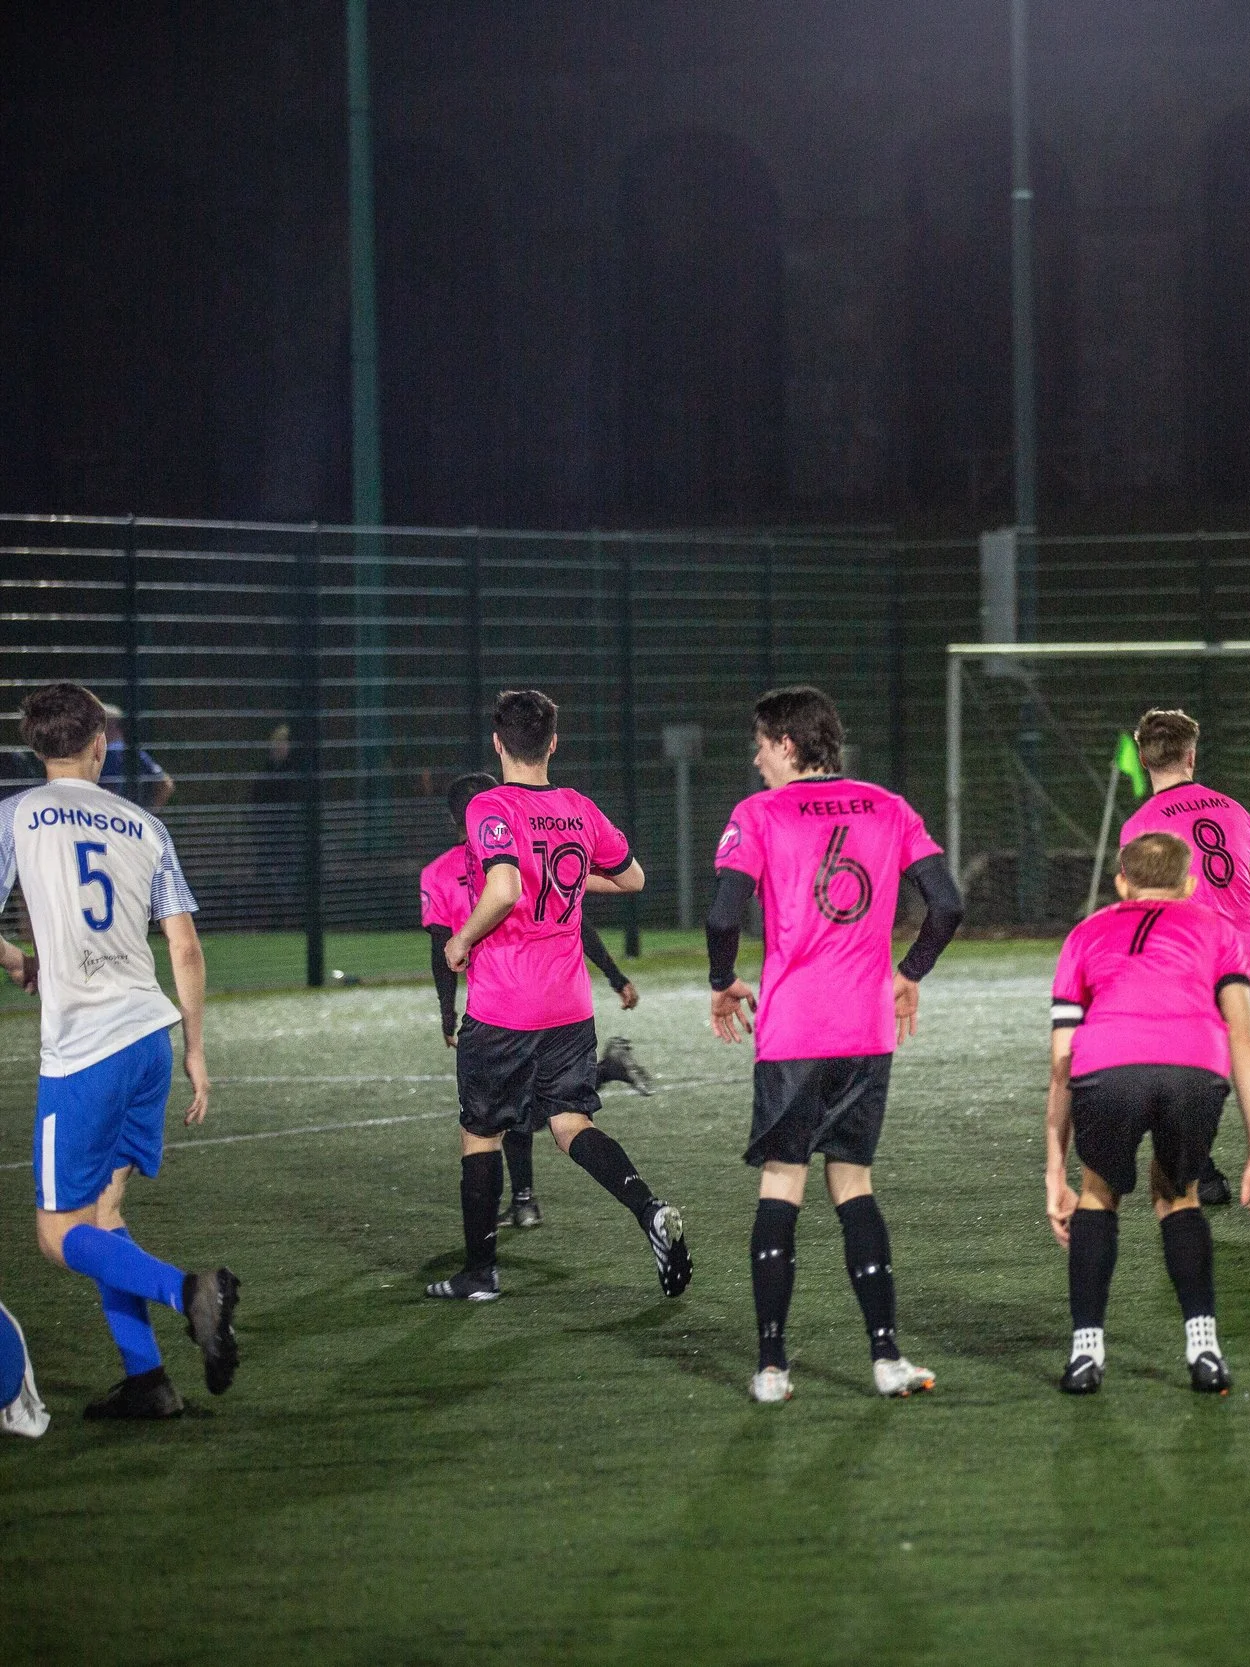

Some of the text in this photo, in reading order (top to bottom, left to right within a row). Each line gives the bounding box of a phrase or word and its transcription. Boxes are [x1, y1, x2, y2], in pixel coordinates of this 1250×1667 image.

[28, 807, 143, 840] JOHNSON
[529, 816, 584, 831] BROOKS
[799, 800, 876, 816] KEELER
[1160, 797, 1230, 818] WILLIAMS
[814, 826, 873, 925] 6
[1192, 818, 1235, 889] 8
[74, 840, 114, 933] 5
[533, 840, 588, 924] 19
[1116, 907, 1165, 956] 7
